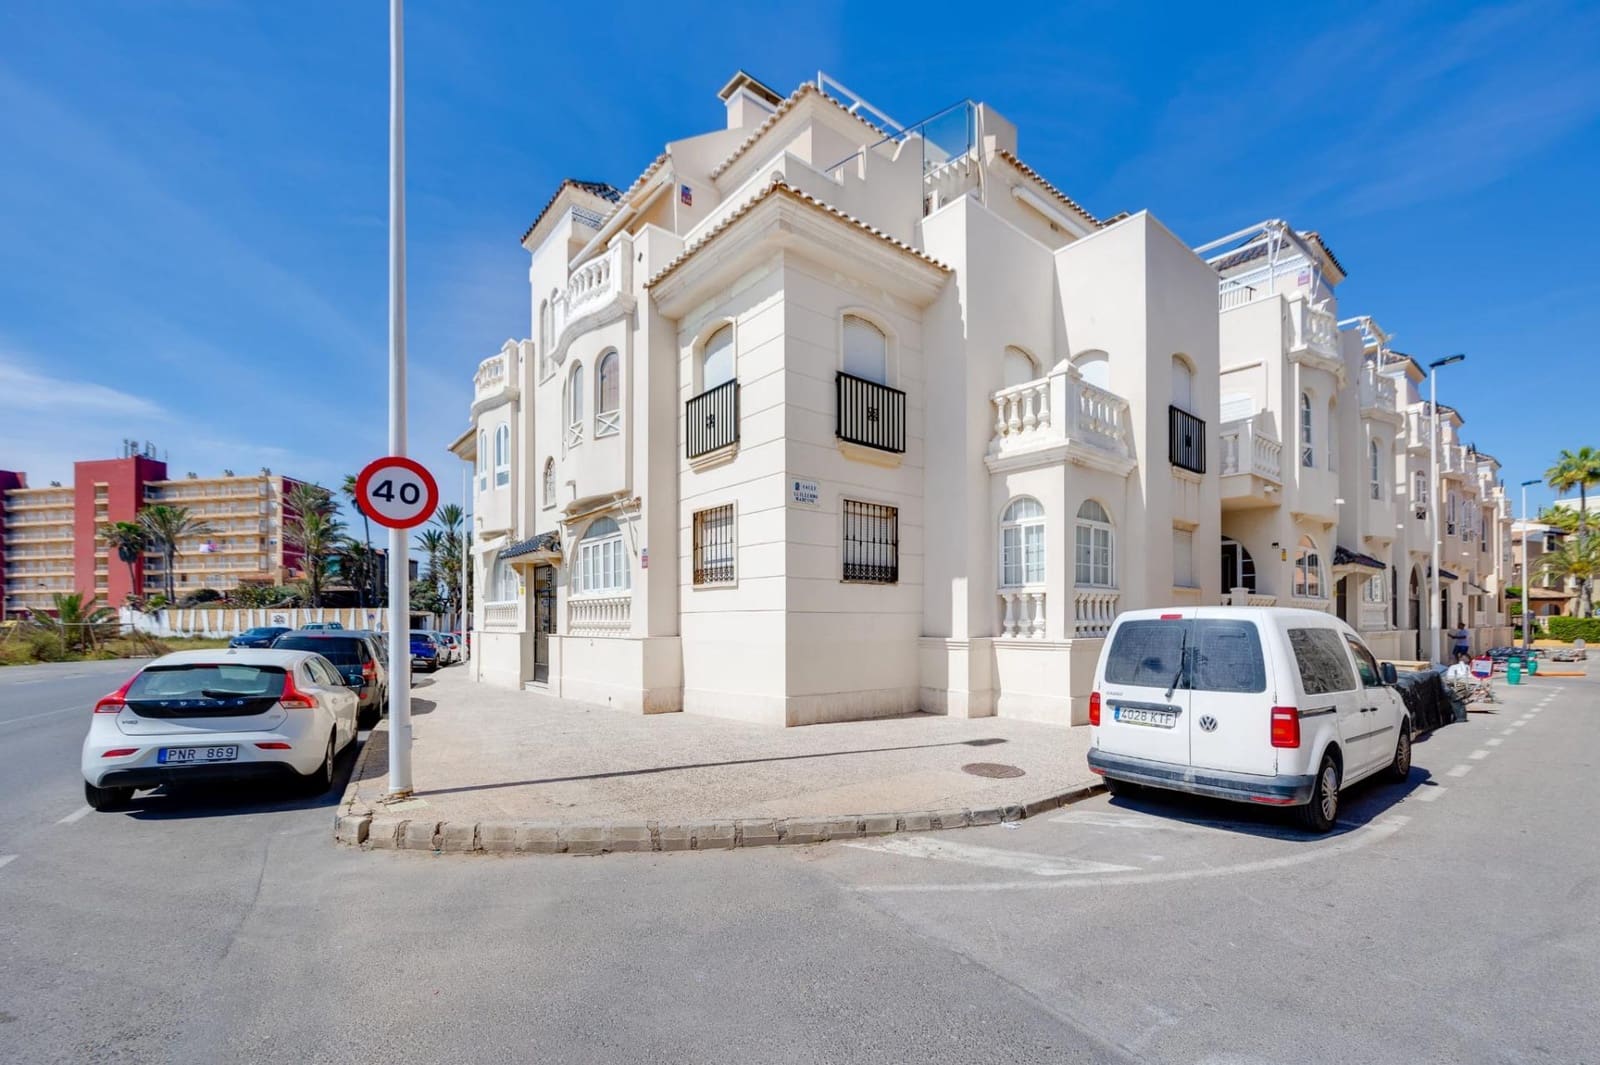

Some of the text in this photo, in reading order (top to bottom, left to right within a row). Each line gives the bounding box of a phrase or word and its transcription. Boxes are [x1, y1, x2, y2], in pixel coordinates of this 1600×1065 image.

[372, 480, 420, 505] 40
[1121, 709, 1173, 725] 4028 KTF
[168, 747, 234, 760] PNR 869
